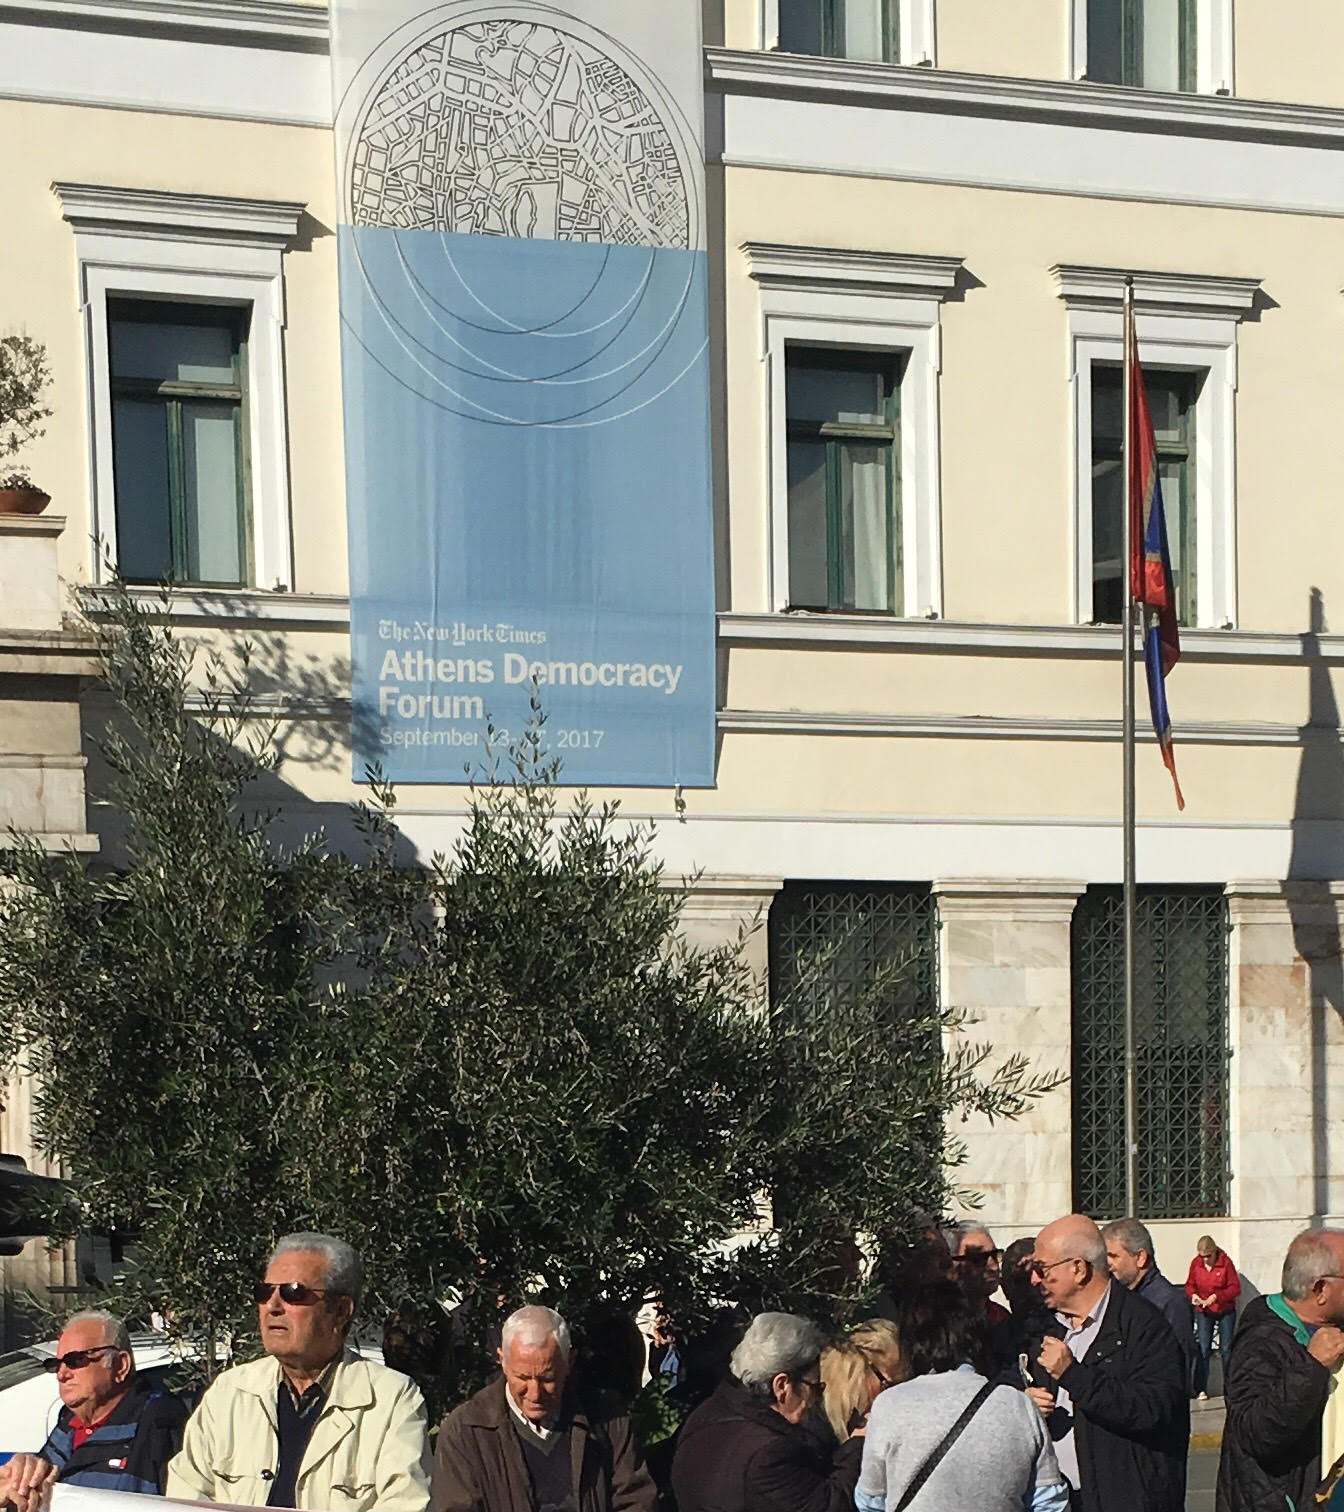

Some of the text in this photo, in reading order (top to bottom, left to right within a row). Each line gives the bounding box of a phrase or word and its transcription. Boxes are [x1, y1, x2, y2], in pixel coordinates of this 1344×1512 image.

[378, 620, 546, 646] The New York Times
[379, 650, 682, 694] Athens Democracy
[379, 686, 483, 719] Forum
[380, 727, 478, 749] September
[557, 730, 604, 748] 2017
